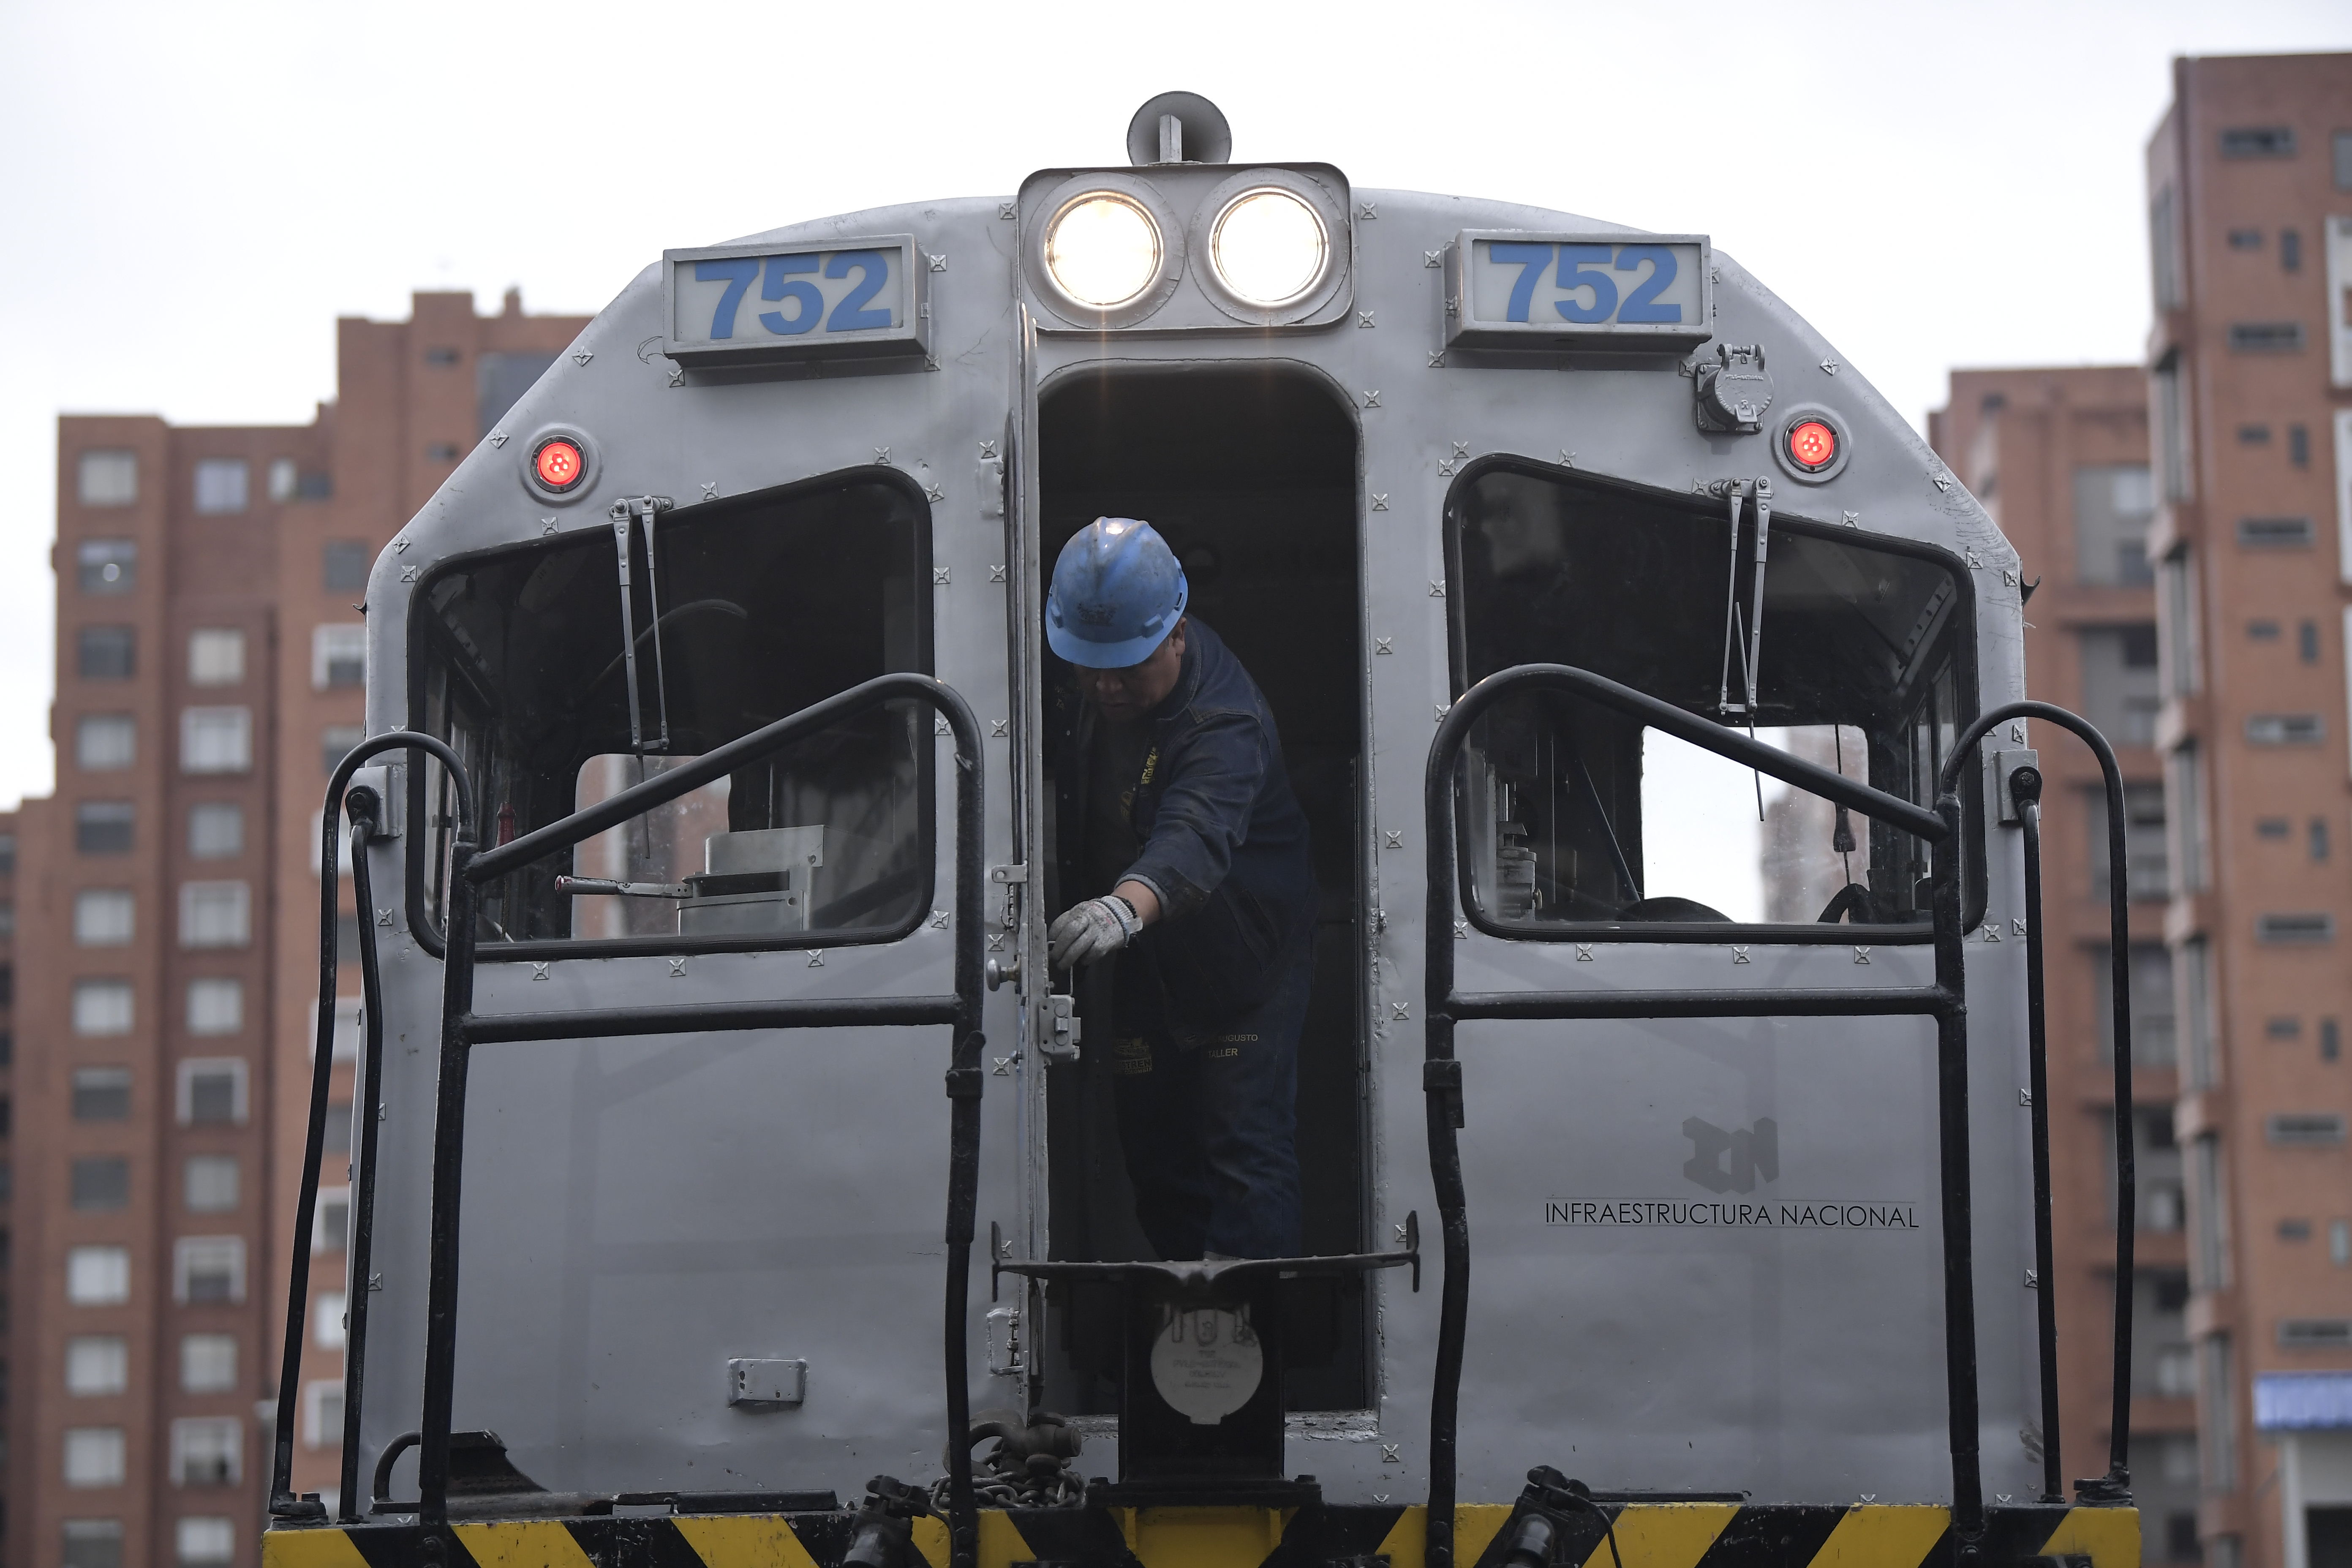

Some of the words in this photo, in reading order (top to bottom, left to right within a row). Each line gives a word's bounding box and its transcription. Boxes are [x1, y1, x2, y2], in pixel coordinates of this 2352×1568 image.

[695, 250, 892, 339] 752
[1489, 243, 1682, 324] 752
[1218, 1034, 1258, 1042] AUGUSTO
[1208, 1048, 1238, 1059] TALLER
[1546, 1202, 1772, 1225] INFRAESTRUCTURA
[1782, 1205, 1919, 1228] NACIONAL
